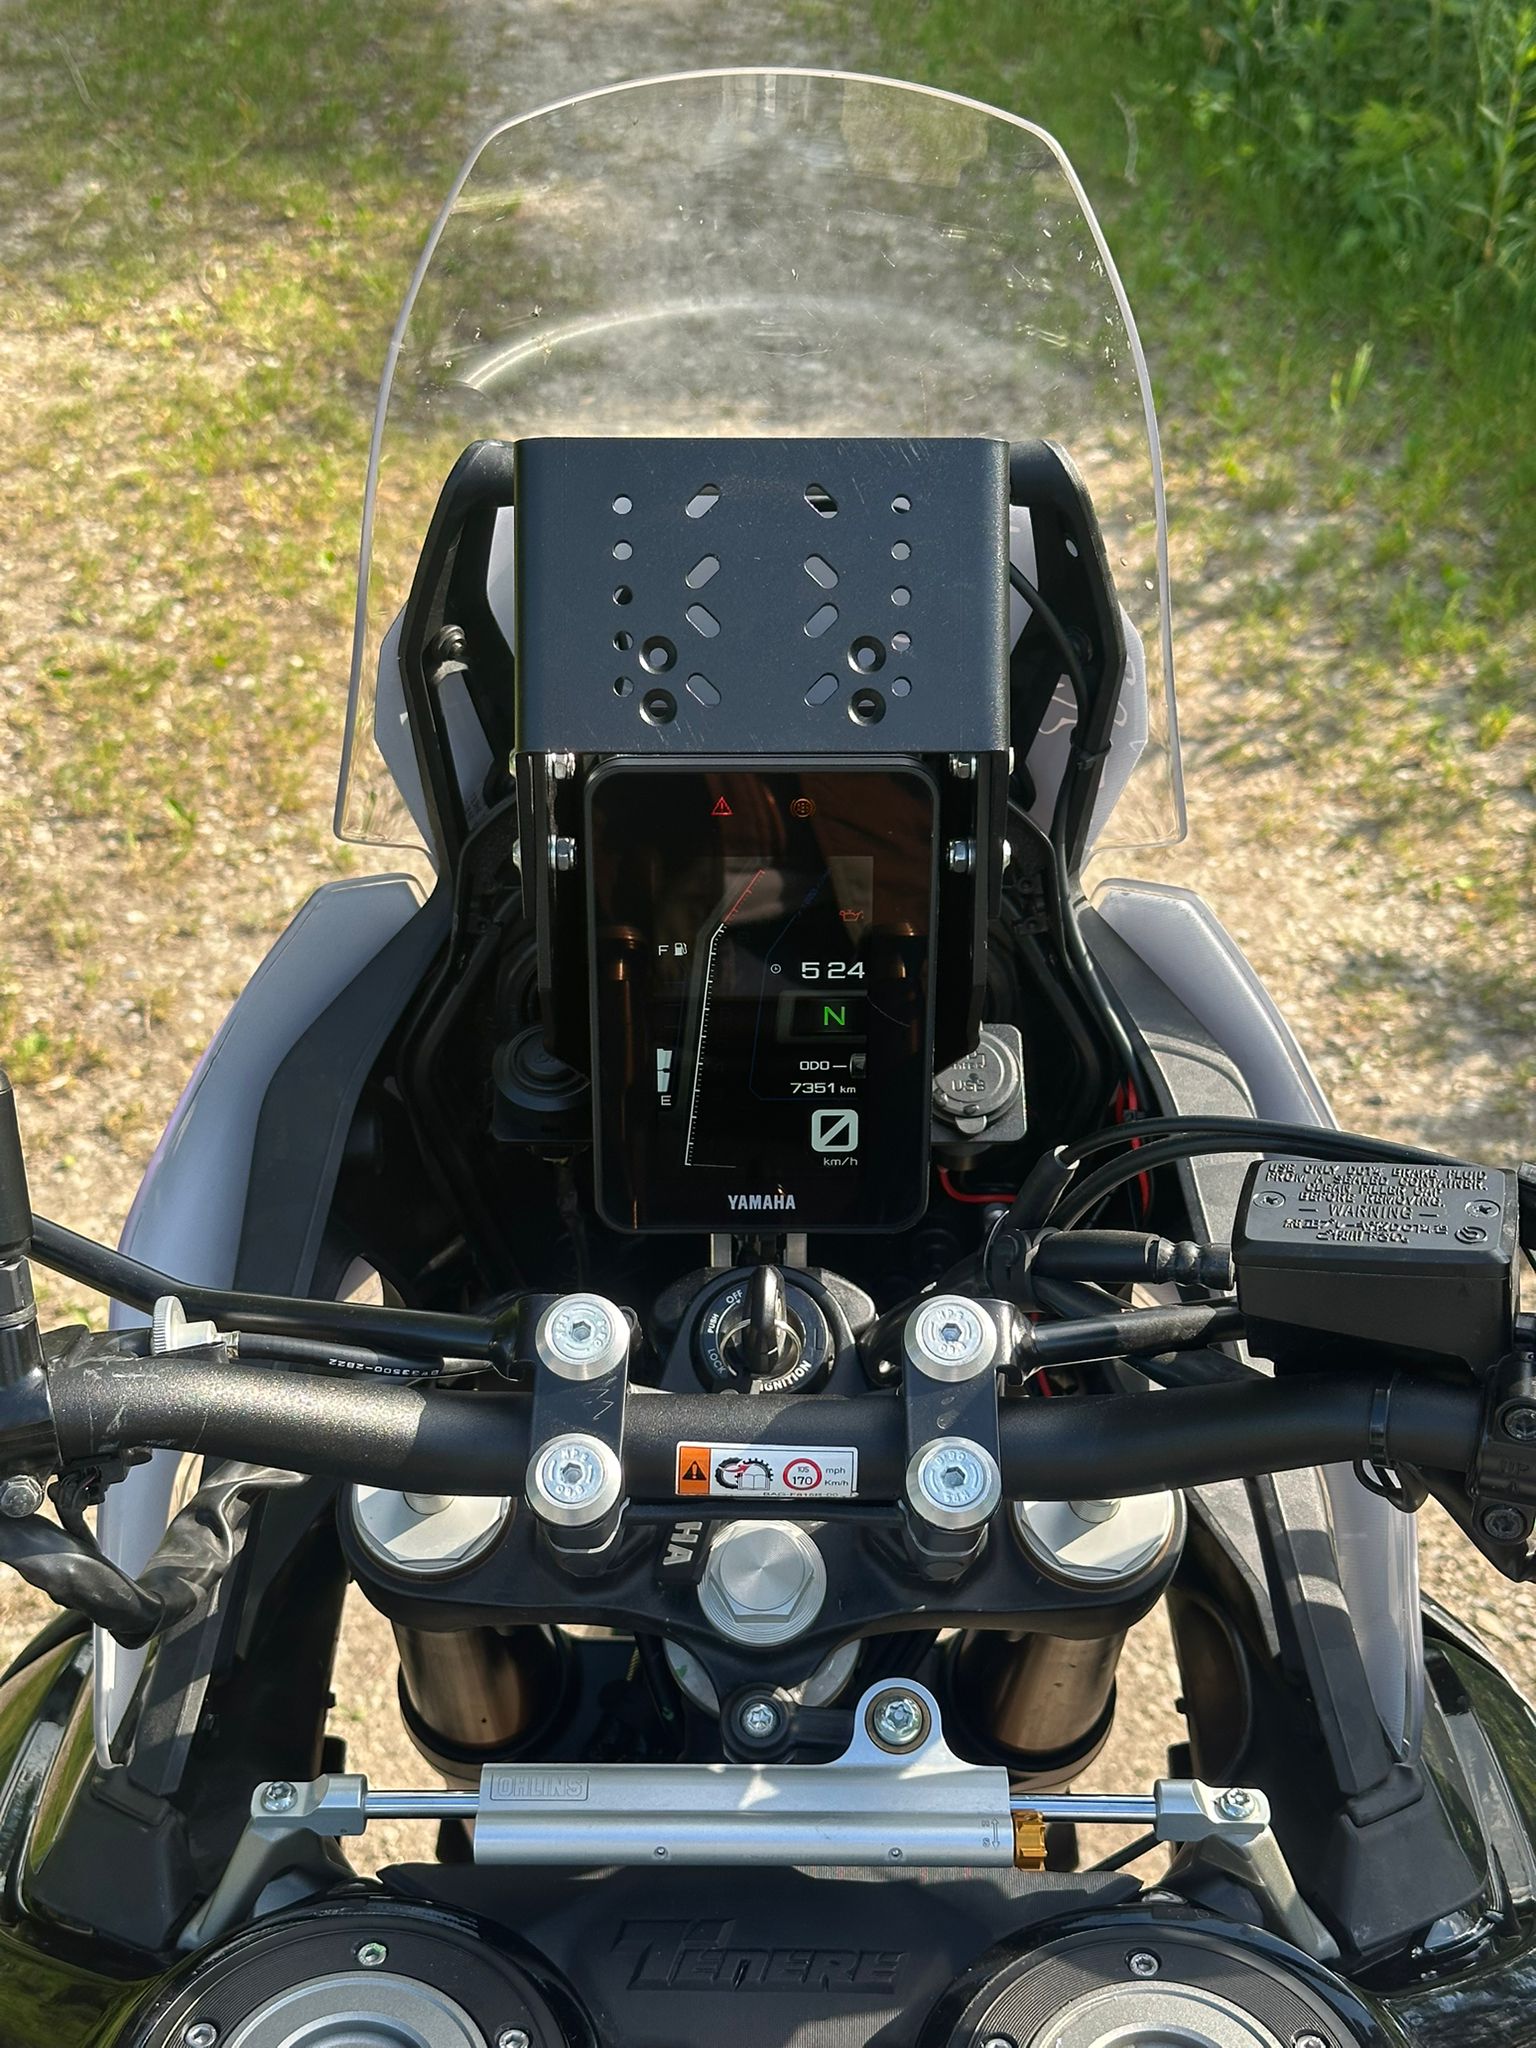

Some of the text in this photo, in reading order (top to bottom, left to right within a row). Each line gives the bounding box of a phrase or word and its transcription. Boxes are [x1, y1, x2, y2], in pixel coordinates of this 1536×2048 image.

[658, 945, 669, 956] F
[823, 1006, 846, 1026] N
[799, 1060, 830, 1071] ODO
[790, 1082, 857, 1094] 7351 km
[951, 1079, 986, 1093] USB
[661, 1094, 671, 1106] E
[811, 1108, 859, 1153] 0
[823, 1156, 858, 1167] km/h
[1266, 1171, 1307, 1184] FROM
[1314, 1174, 1325, 1185] A
[1333, 1175, 1389, 1186] SEALED
[1268, 1163, 1296, 1174] USE
[1303, 1164, 1339, 1176] ONLY
[1391, 1167, 1439, 1179] BRAKE
[1305, 1182, 1352, 1194] CLEAN
[1359, 1184, 1406, 1196] FILLER
[727, 1194, 796, 1210] YAMAHA
[1299, 1191, 1446, 1208] BEFORE REMOVING.
[1328, 1204, 1413, 1220] WARNING
[725, 1289, 744, 1304] OFF
[708, 1313, 719, 1334] PUSH
[707, 1347, 727, 1375] LOCK
[759, 1359, 812, 1392] IGNITION
[796, 1466, 846, 1476] 105 mph
[791, 1476, 849, 1487] 170 Km/h
